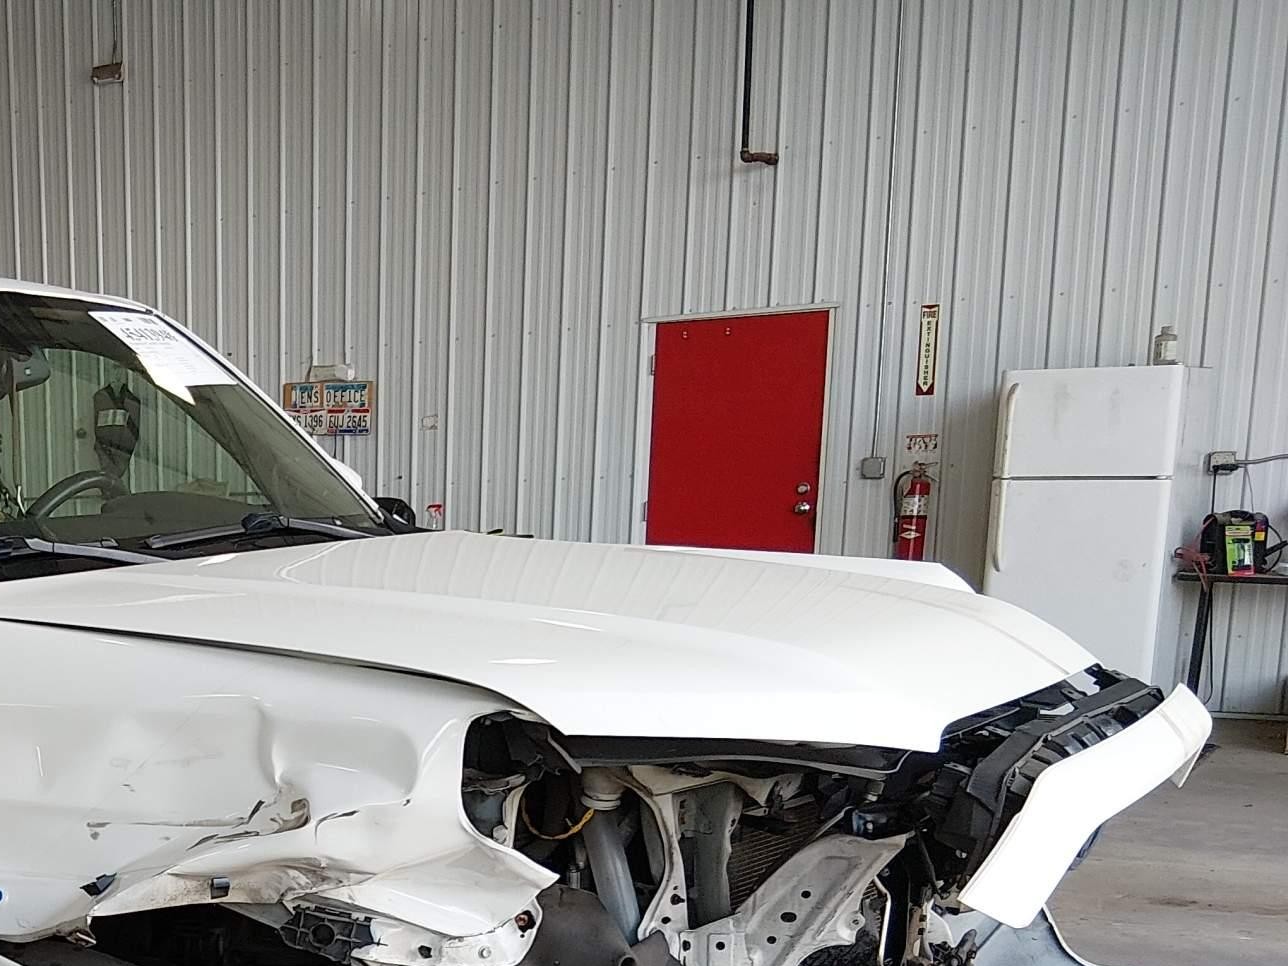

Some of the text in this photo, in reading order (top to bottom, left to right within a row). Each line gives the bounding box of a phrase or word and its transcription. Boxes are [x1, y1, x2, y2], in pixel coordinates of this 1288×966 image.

[923, 311, 937, 319] FIRE
[922, 321, 932, 387] EXTINGUISHER
[325, 390, 366, 403] OFFICE
[304, 414, 324, 428] 1396
[347, 415, 368, 428] 2645
